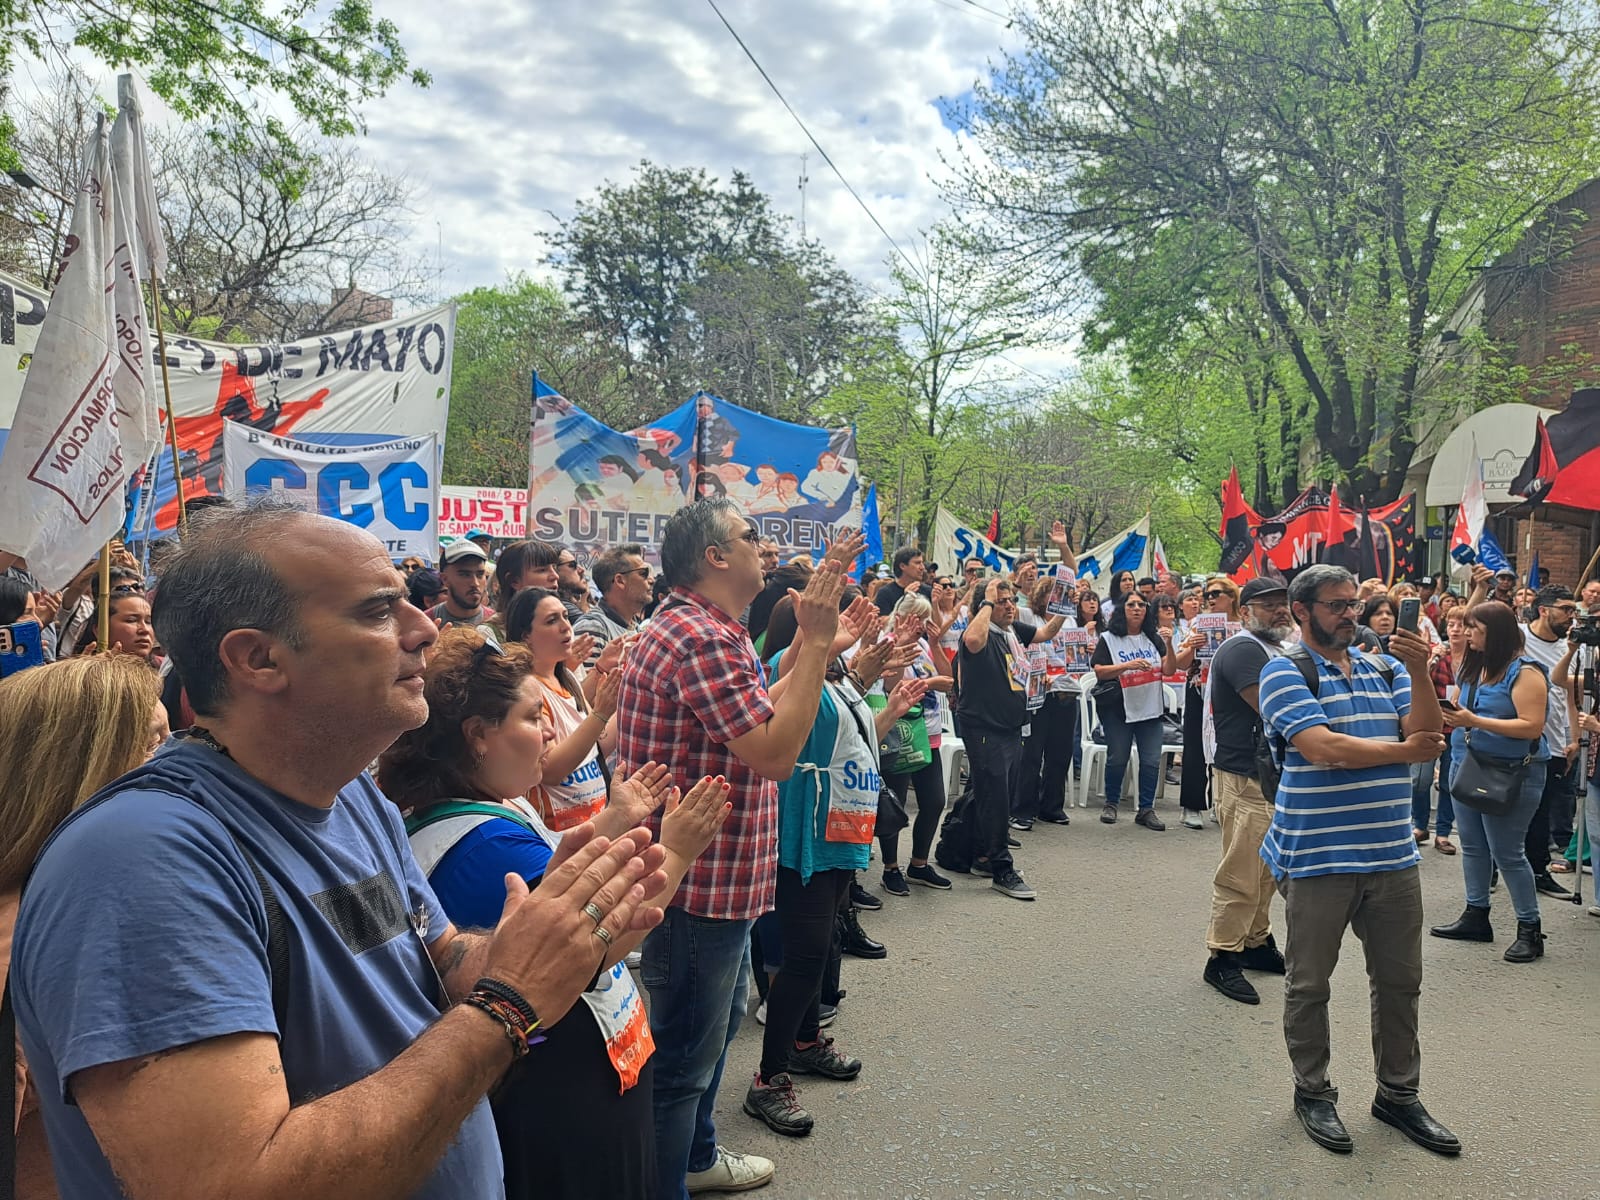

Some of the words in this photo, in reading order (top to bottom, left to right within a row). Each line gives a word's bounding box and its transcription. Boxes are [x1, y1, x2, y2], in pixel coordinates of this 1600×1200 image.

[316, 322, 446, 378] MAYO
[438, 498, 528, 522] JUST
[503, 523, 525, 536] RUB
[381, 540, 407, 551] TE
[953, 527, 1102, 583] SUTA
[843, 760, 880, 792] Sute
